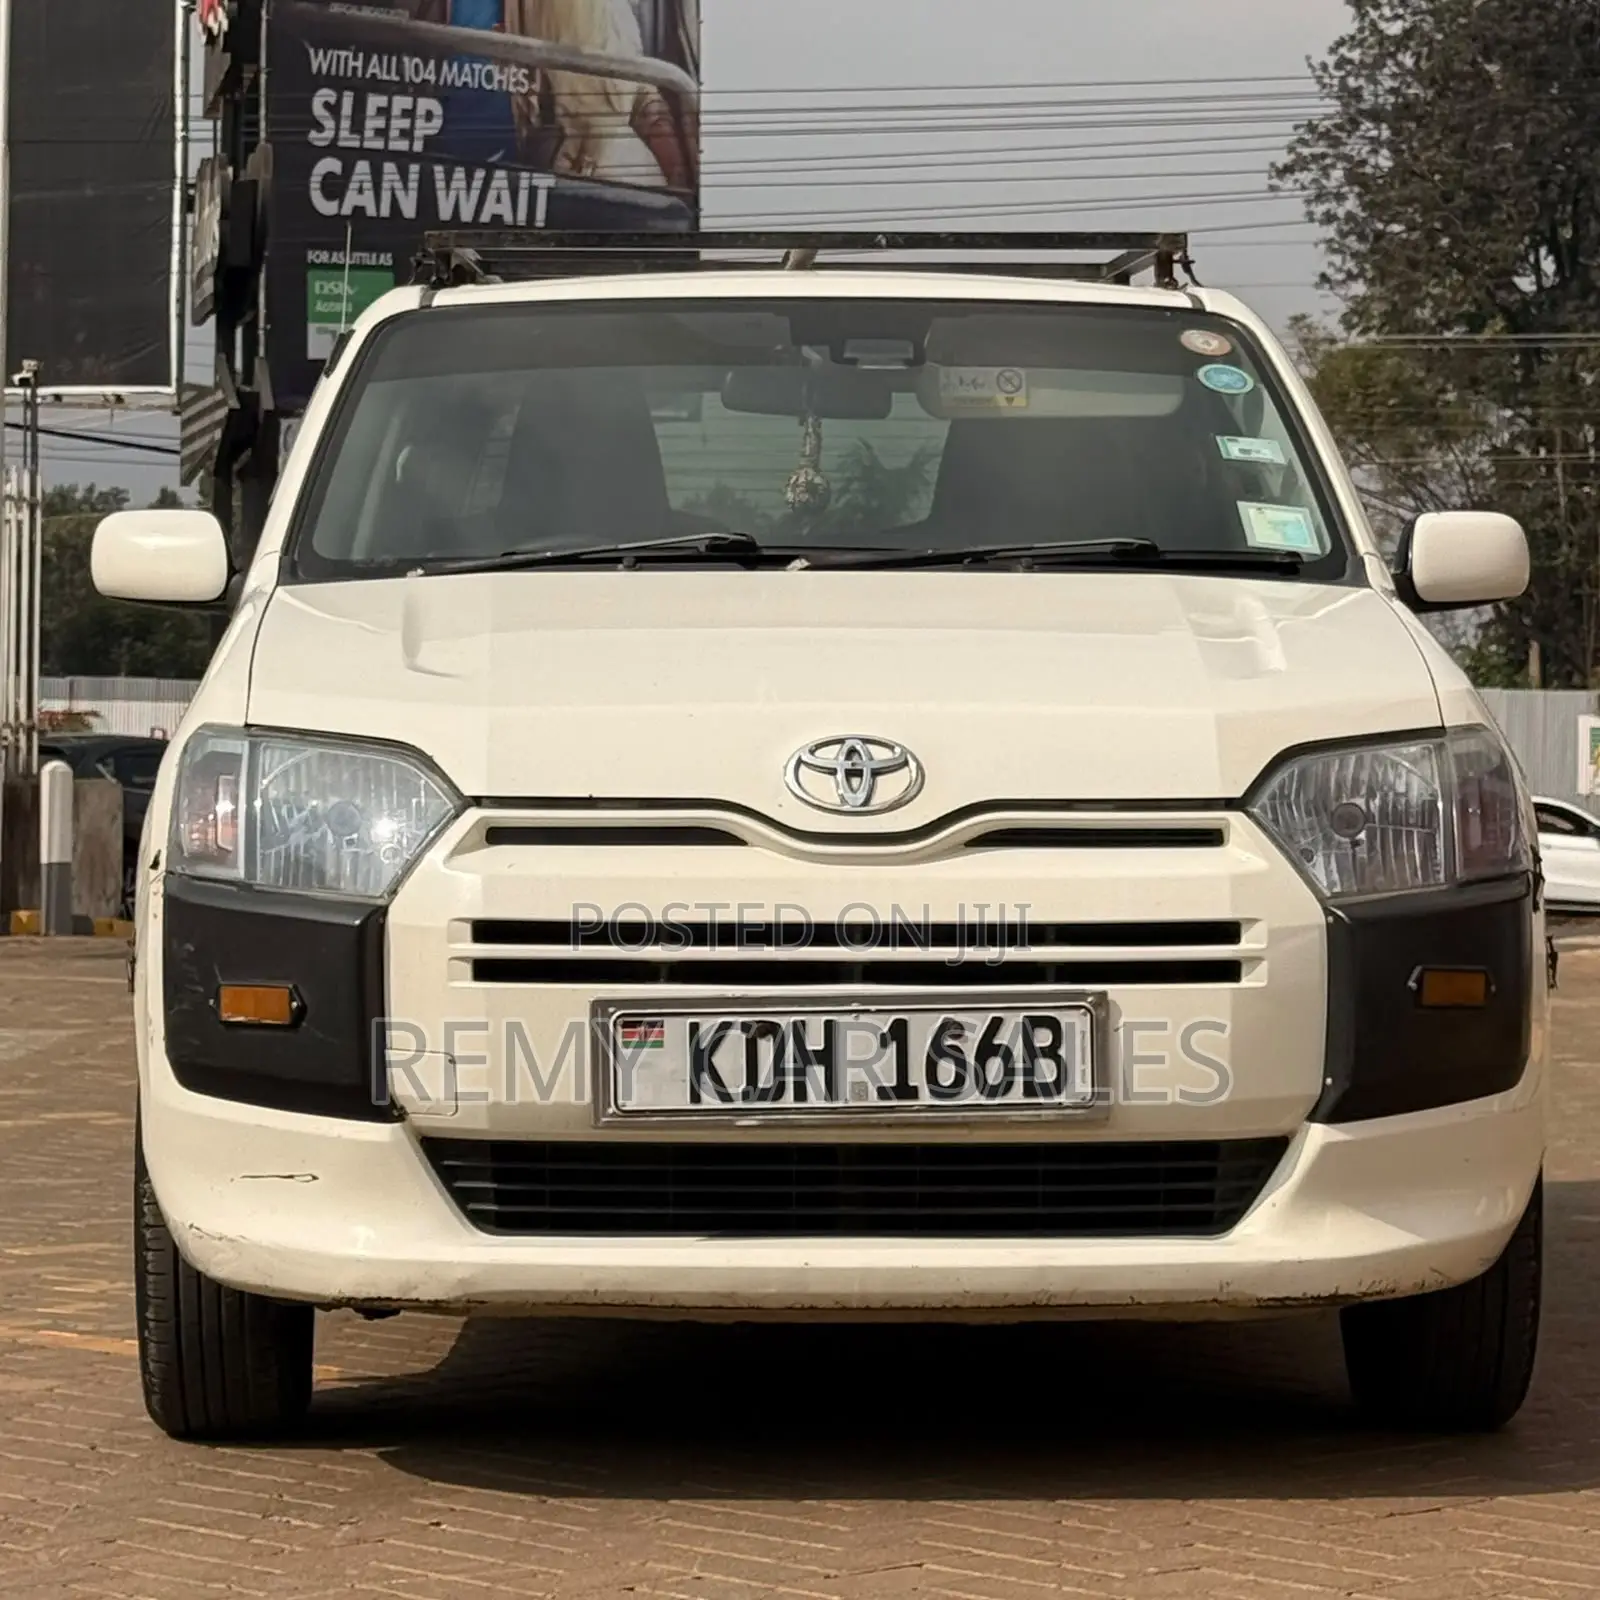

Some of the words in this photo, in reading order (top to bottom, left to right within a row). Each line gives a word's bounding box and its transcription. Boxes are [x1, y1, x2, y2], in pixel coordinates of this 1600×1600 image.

[308, 47, 364, 78] WITH
[365, 53, 400, 82] ALL
[402, 55, 437, 84] 104
[307, 88, 443, 153] SLEEP
[309, 156, 421, 219] CAN
[433, 163, 556, 227] WAIT
[307, 250, 329, 264] FOR
[331, 251, 346, 265] AS
[379, 253, 393, 266] AS
[687, 1017, 839, 1104] KDH
[876, 1014, 1068, 1102] 166B
